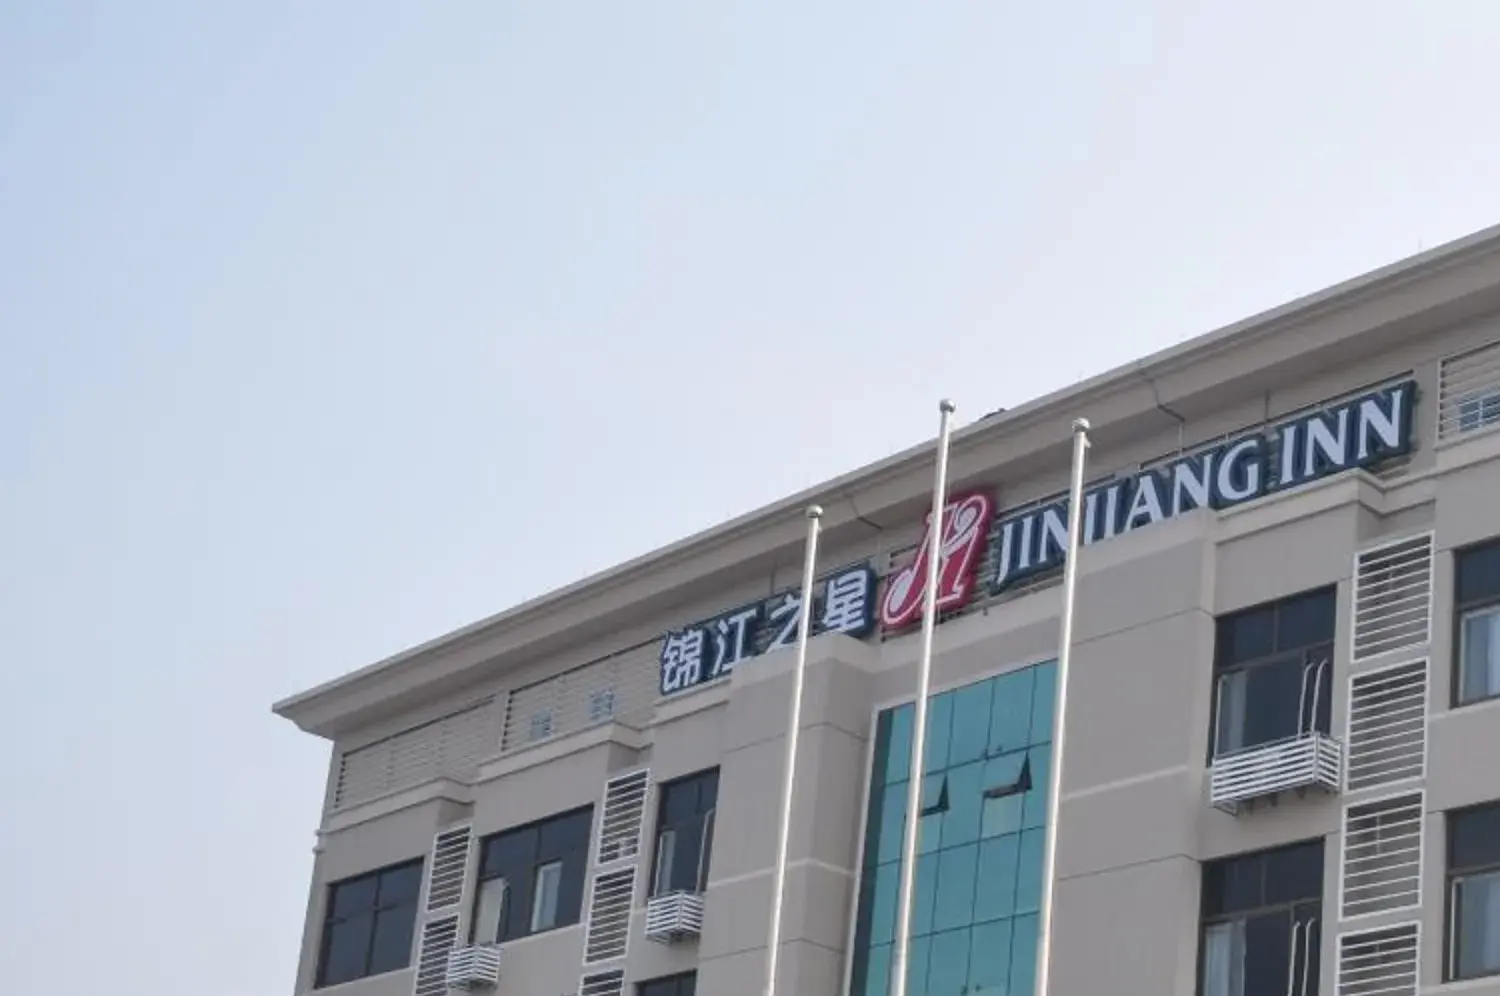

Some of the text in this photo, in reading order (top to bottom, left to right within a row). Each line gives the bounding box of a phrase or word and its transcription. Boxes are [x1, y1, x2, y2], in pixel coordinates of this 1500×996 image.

[1279, 389, 1403, 486] INN
[662, 568, 869, 693] 锦江之星
